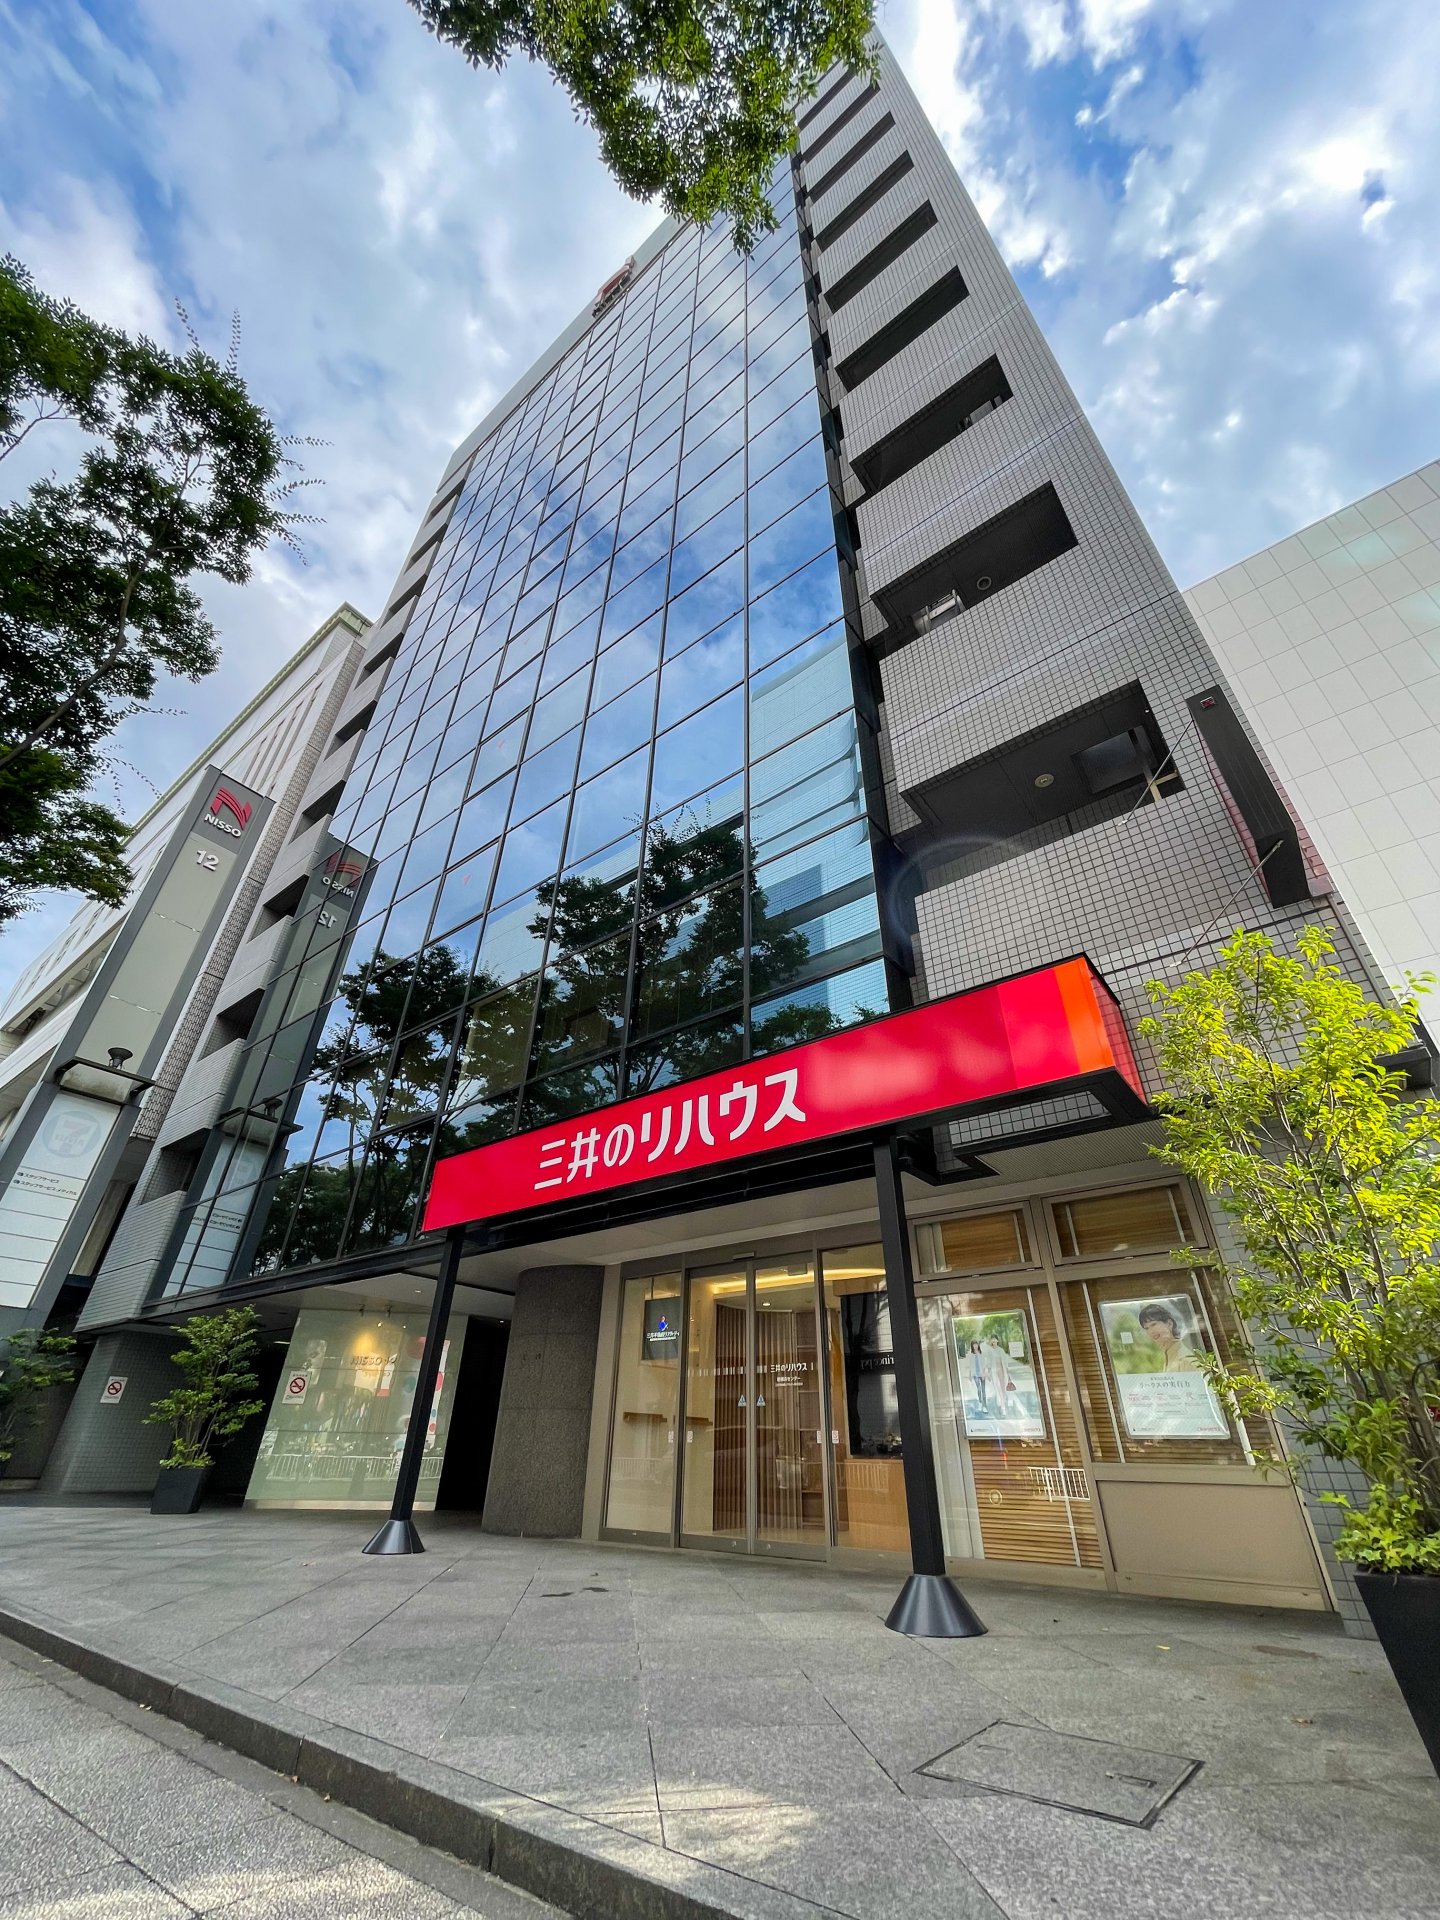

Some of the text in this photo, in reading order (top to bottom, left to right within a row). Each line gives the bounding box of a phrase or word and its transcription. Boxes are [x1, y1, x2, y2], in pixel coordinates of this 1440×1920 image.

[204, 812, 243, 838] NISSO
[195, 849, 220, 872] 12
[533, 1067, 807, 1191] 三井のリハウス
[770, 1362, 808, 1373] 三井のリハウス
